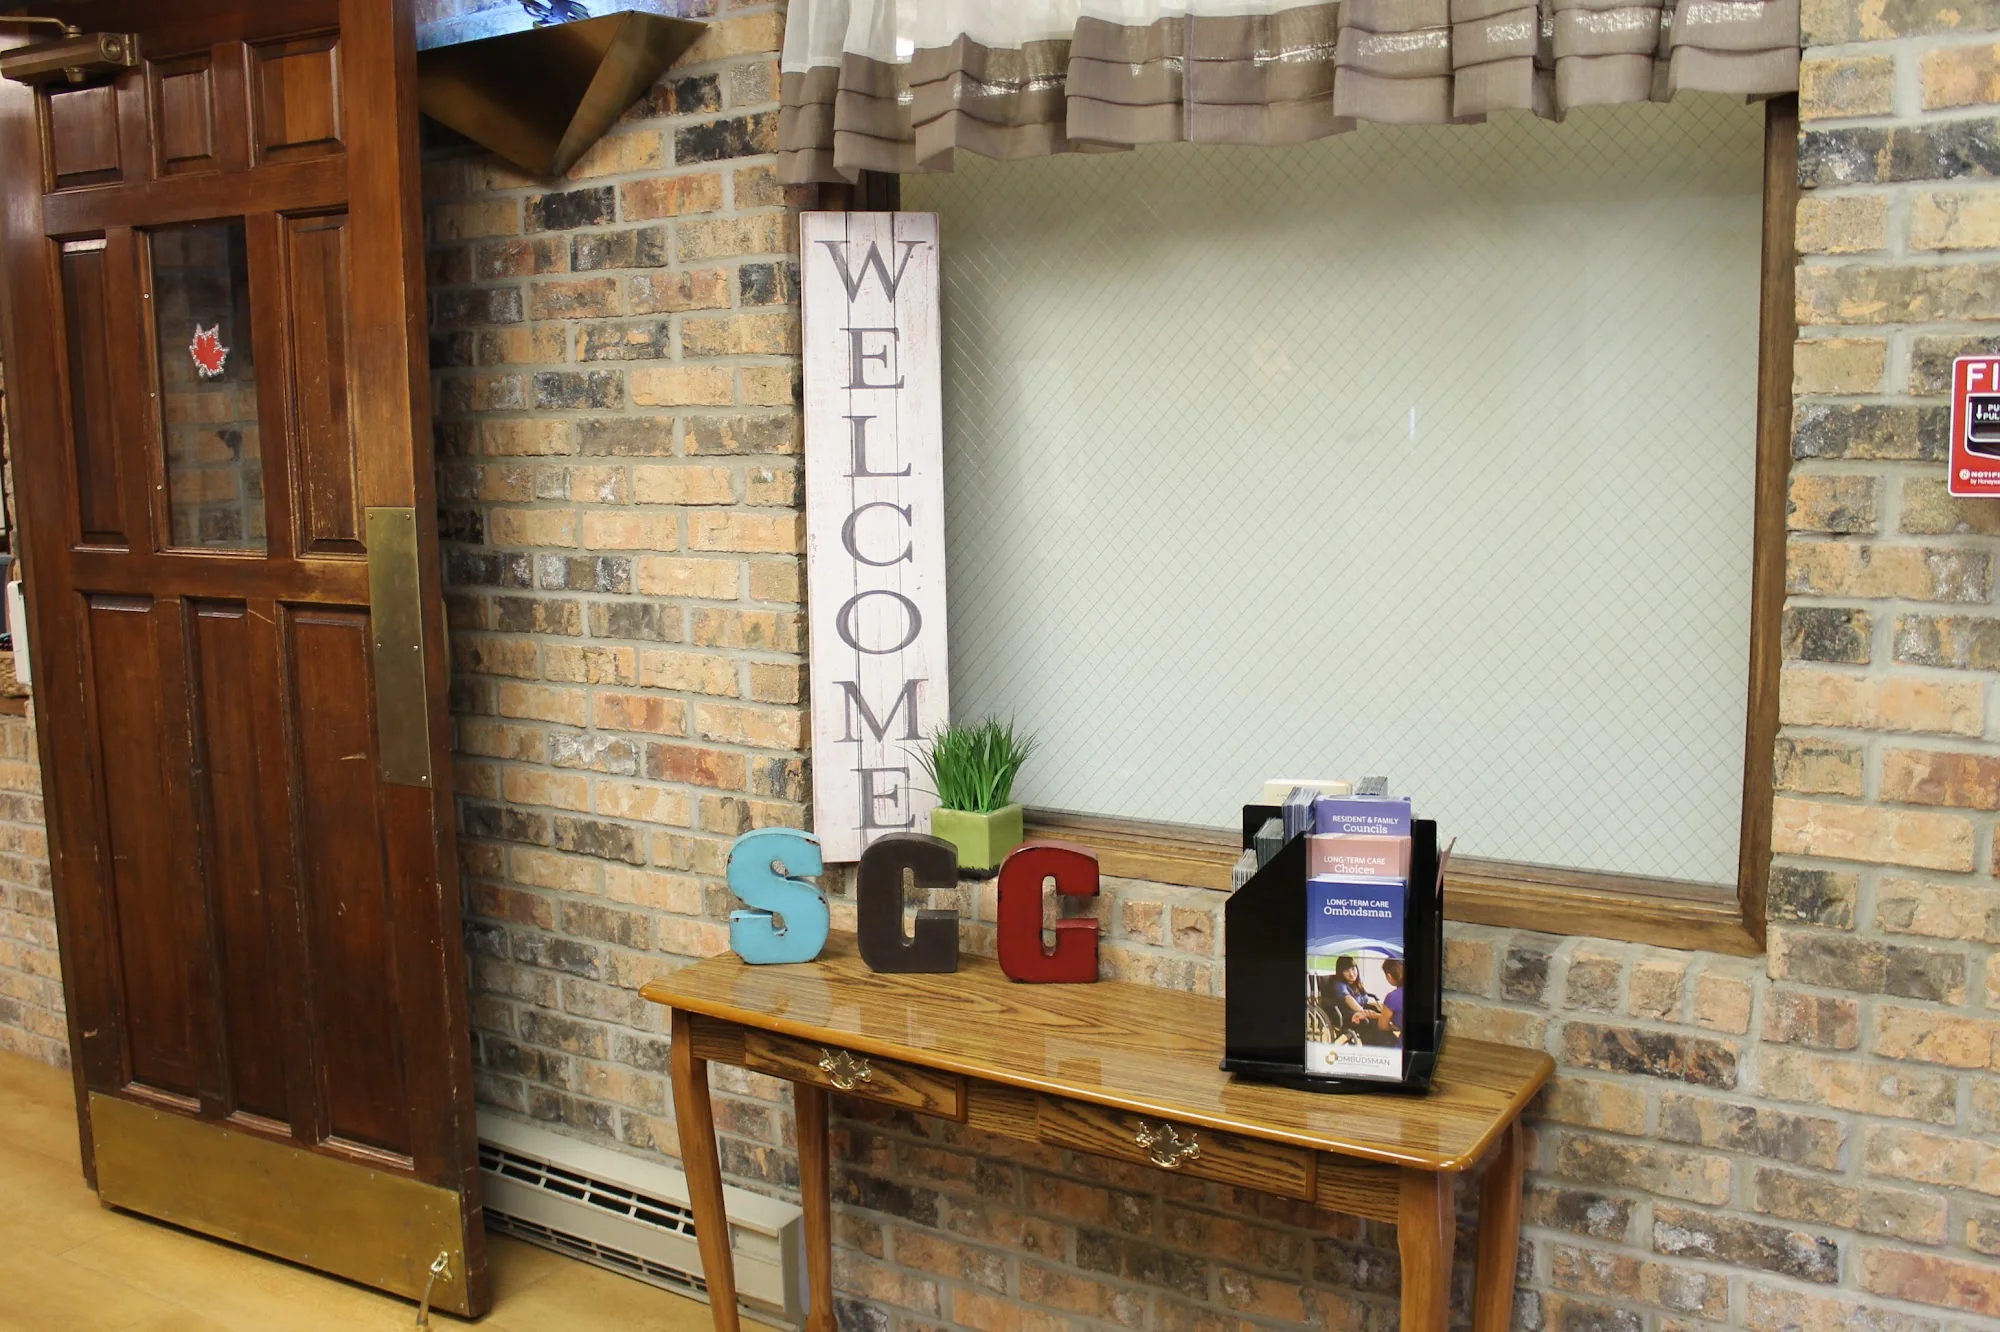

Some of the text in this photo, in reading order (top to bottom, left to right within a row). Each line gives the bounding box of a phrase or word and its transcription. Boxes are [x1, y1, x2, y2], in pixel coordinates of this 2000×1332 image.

[814, 240, 928, 830] WELCOME
[1332, 815, 1399, 825] RESIDENT & FAMILY
[1343, 823, 1388, 834] Councils
[1323, 856, 1386, 865] LONG-TERM CARE
[1334, 864, 1375, 875] Choices
[1326, 898, 1390, 908] LONG-TERM CARE
[1323, 906, 1392, 918] Ombudsman
